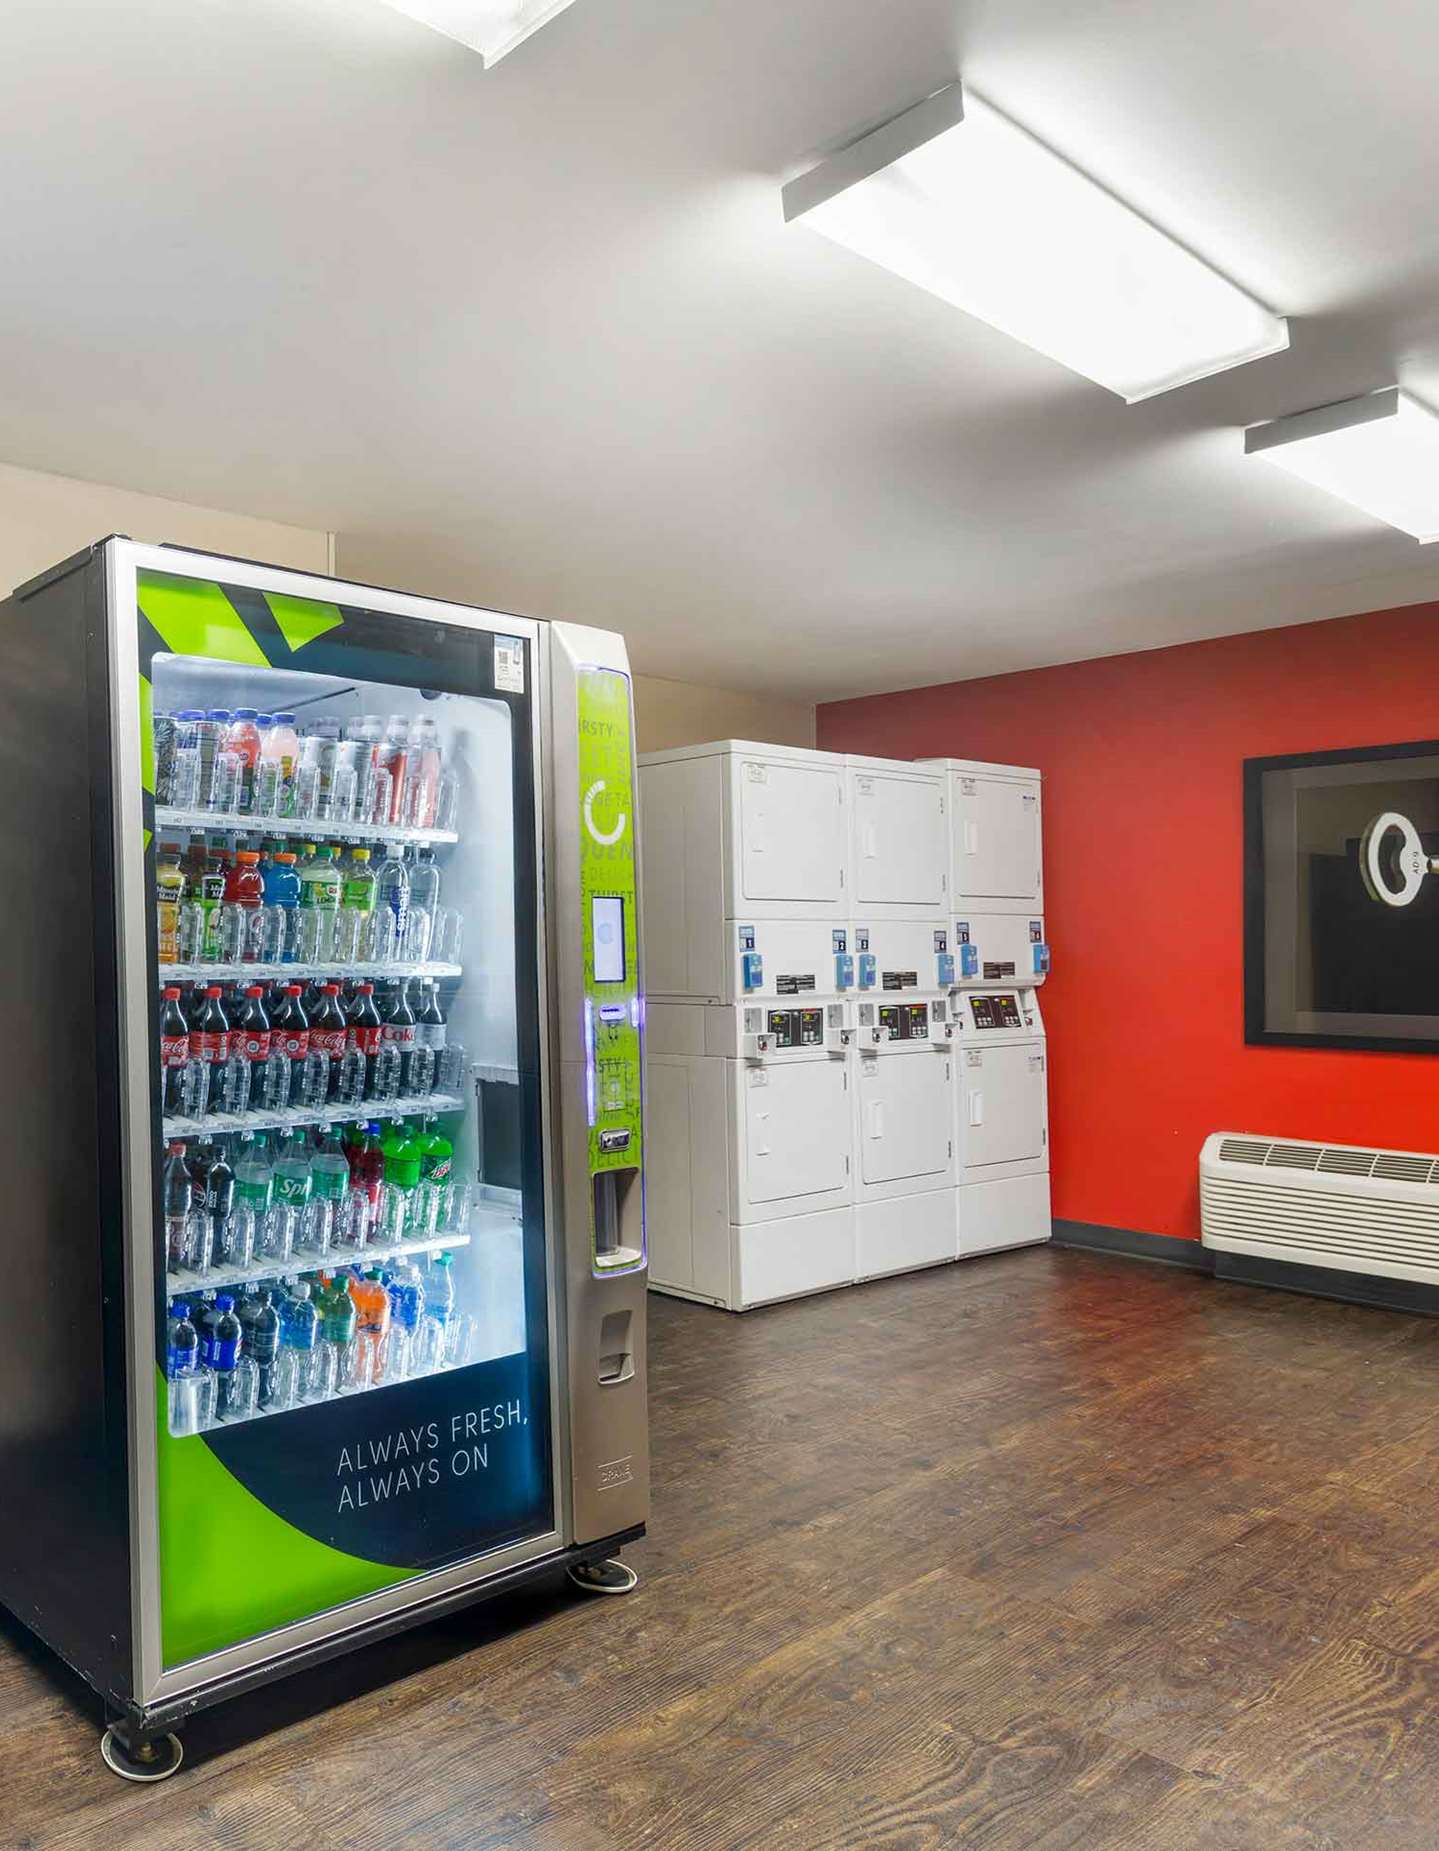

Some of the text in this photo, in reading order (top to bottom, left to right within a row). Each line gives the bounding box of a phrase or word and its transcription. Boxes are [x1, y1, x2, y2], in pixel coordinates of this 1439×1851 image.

[337, 1399, 529, 1476] ALWAYS FRESH,
[338, 1443, 488, 1513] ALWAYS ON
